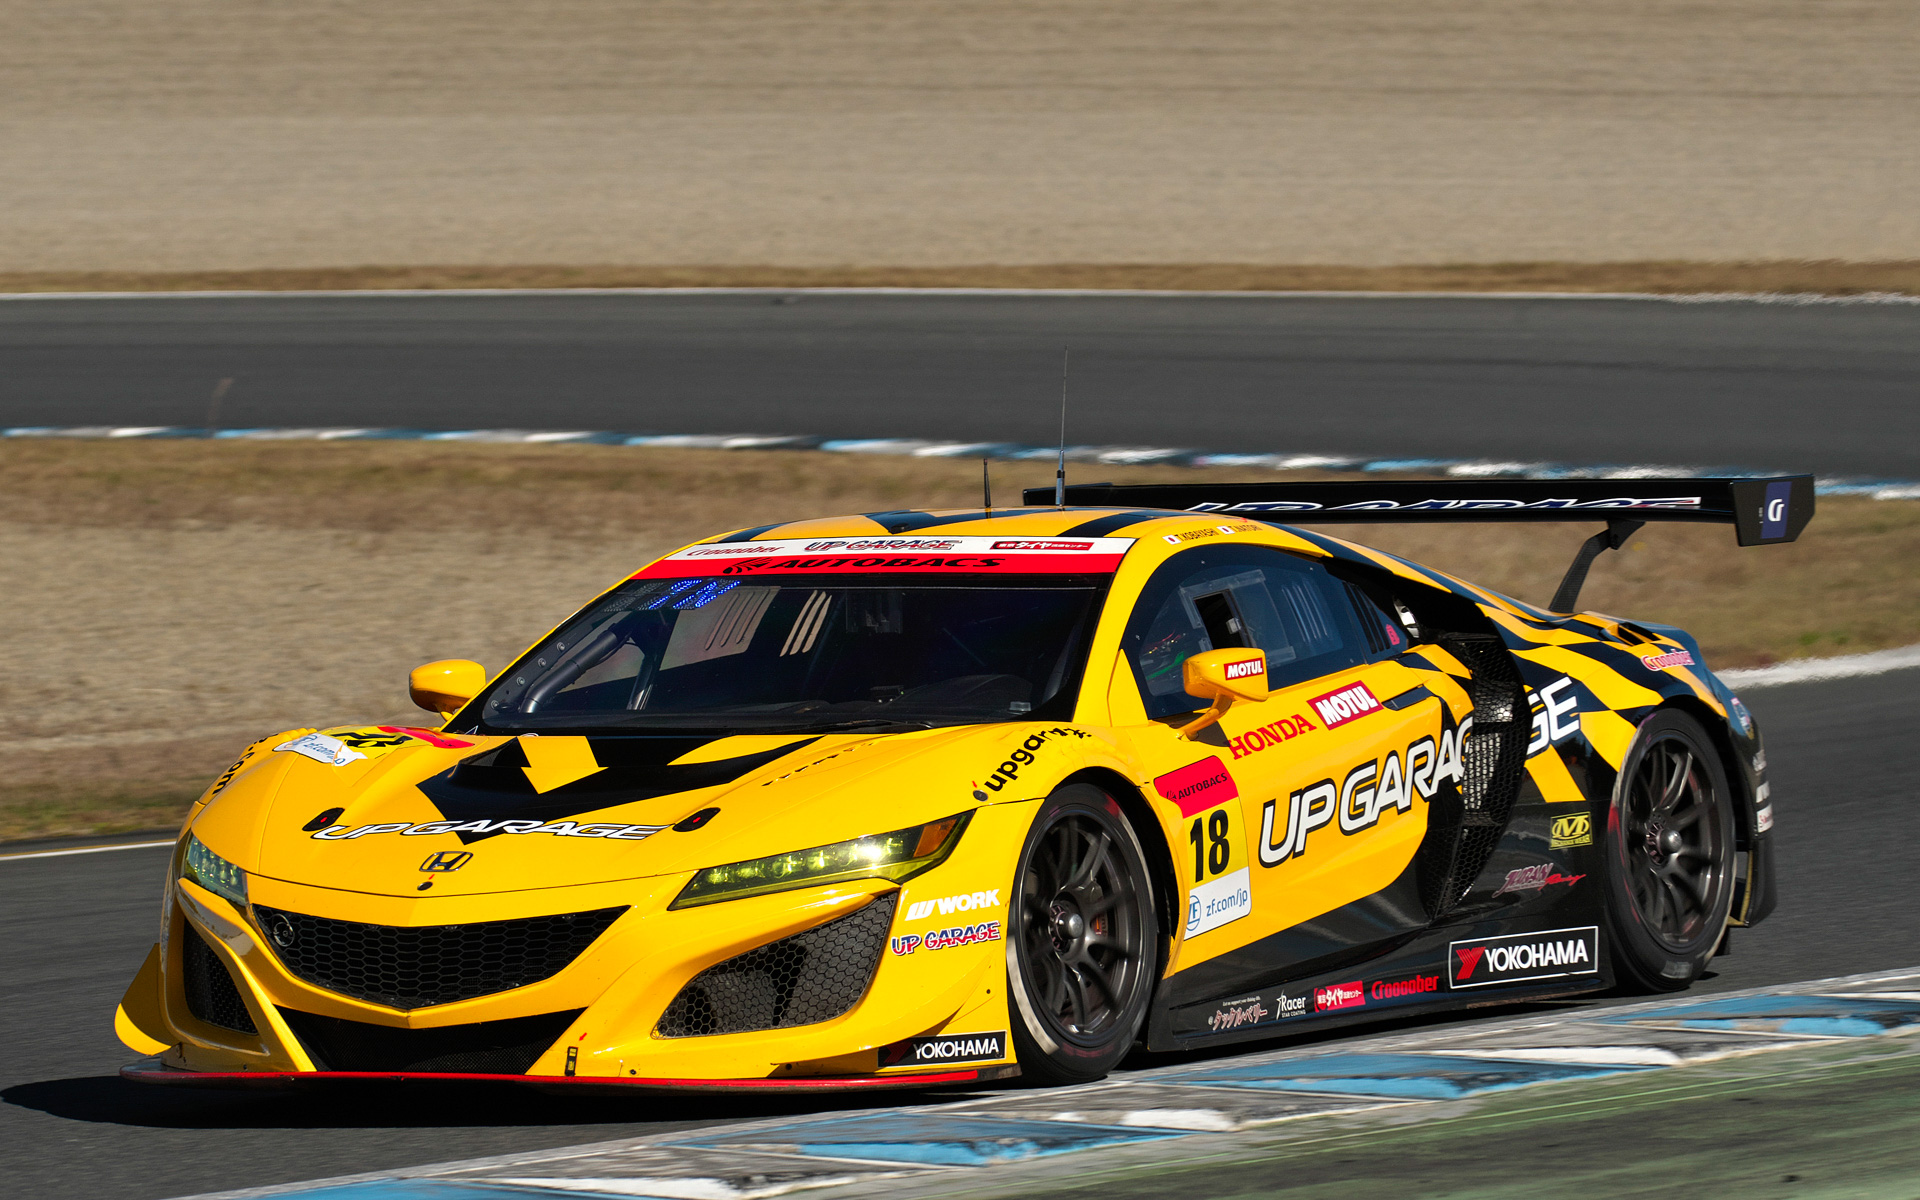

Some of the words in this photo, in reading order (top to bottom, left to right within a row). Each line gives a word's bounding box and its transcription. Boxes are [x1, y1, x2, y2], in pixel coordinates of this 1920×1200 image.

[804, 540, 847, 552] UP
[846, 540, 962, 551] GARAGE
[765, 558, 1006, 569] AUTOBACS
[1227, 660, 1263, 678] MOTUL
[1317, 684, 1379, 725] MOTUL
[1227, 714, 1317, 760] HONDA
[1178, 773, 1228, 799] AUTOBACS
[311, 822, 413, 840] UP
[400, 819, 675, 840] GARAGE
[1259, 783, 1335, 866] UP
[1190, 809, 1230, 883] 18
[936, 889, 1000, 915] WORK
[1206, 888, 1248, 917] zf.com/jp
[891, 933, 921, 955] UP
[924, 920, 1001, 950] GARAGE
[1485, 939, 1588, 973] YOKOHAMA
[1371, 974, 1439, 1000] Croooober
[1281, 995, 1306, 1012] Racer
[913, 1038, 999, 1060] YOKOHAMA
